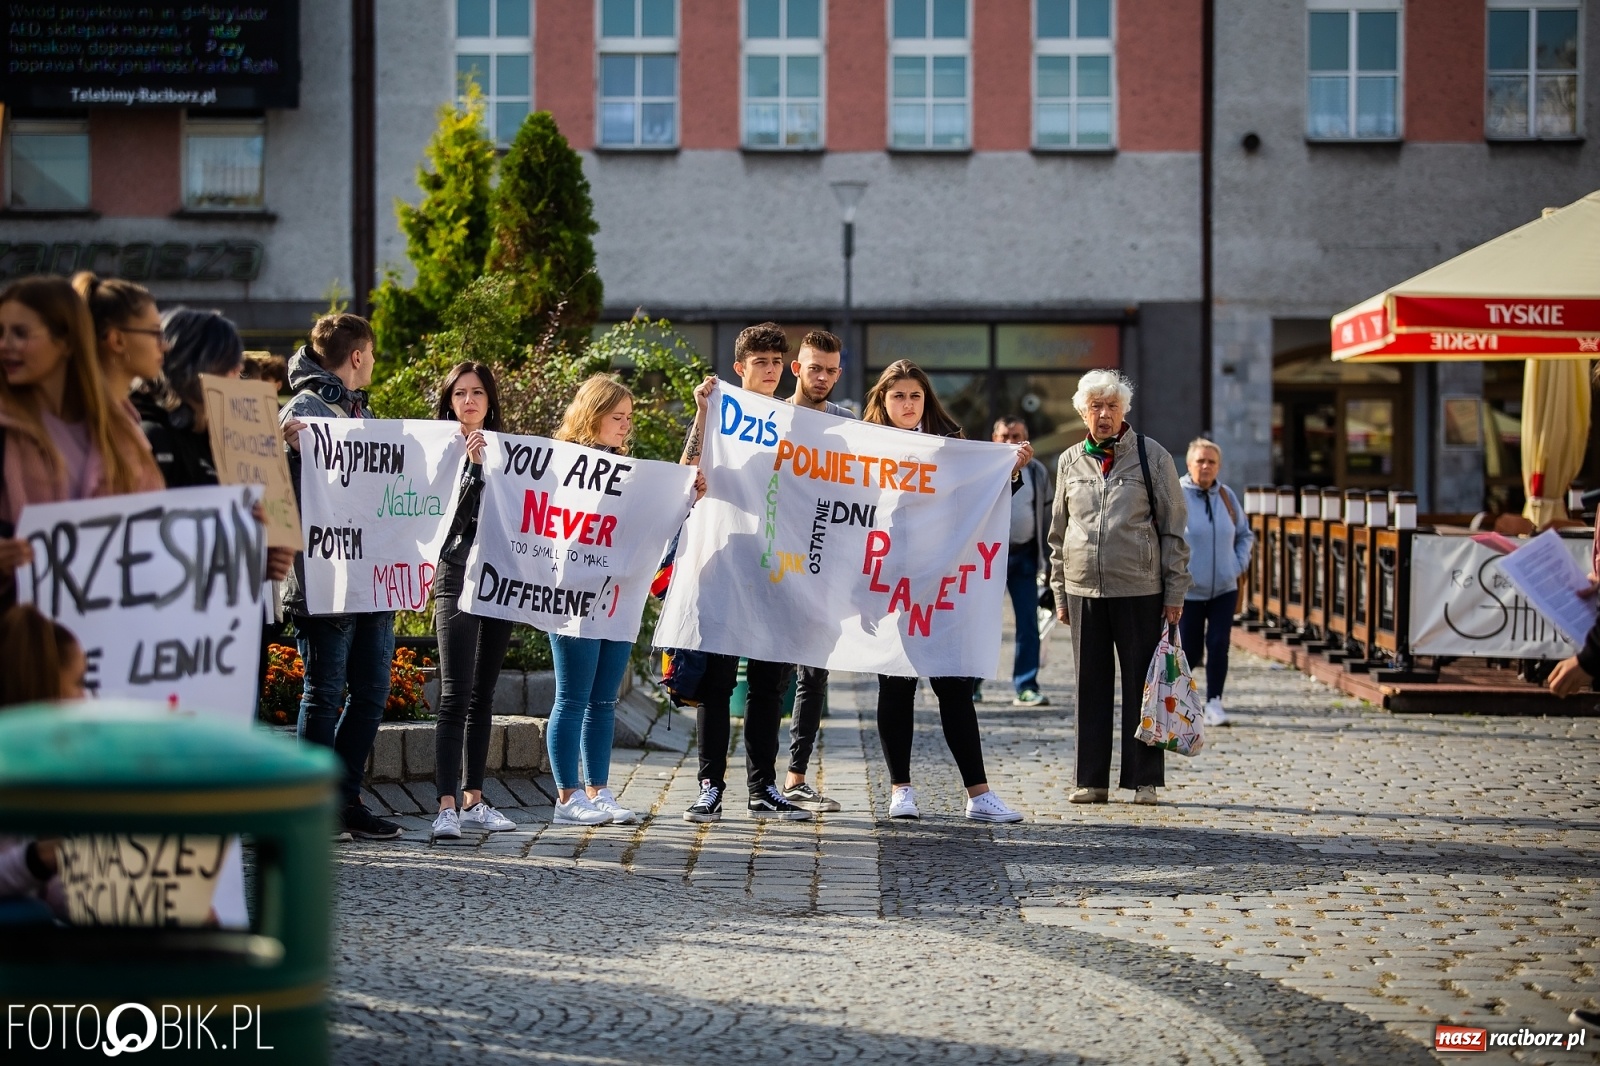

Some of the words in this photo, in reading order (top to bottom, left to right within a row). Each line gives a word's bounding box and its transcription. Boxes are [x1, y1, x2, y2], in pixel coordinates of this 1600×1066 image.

[1485, 304, 1564, 325] TYSKIE
[502, 440, 554, 481] YOU
[563, 453, 632, 497] ARE
[773, 438, 938, 494] POWIETRZE
[376, 474, 446, 518] Natura
[520, 489, 618, 549] NEVER
[510, 540, 528, 555] TOO
[532, 544, 560, 560] SMALL
[566, 549, 578, 562] TO
[583, 554, 610, 568] MAKE
[808, 497, 831, 575] OSTATNIE
[830, 500, 878, 529] DNI
[551, 562, 559, 573] A
[769, 550, 808, 584] JAK
[862, 530, 1003, 638] PLANETY
[128, 617, 241, 685] LENIĆ
